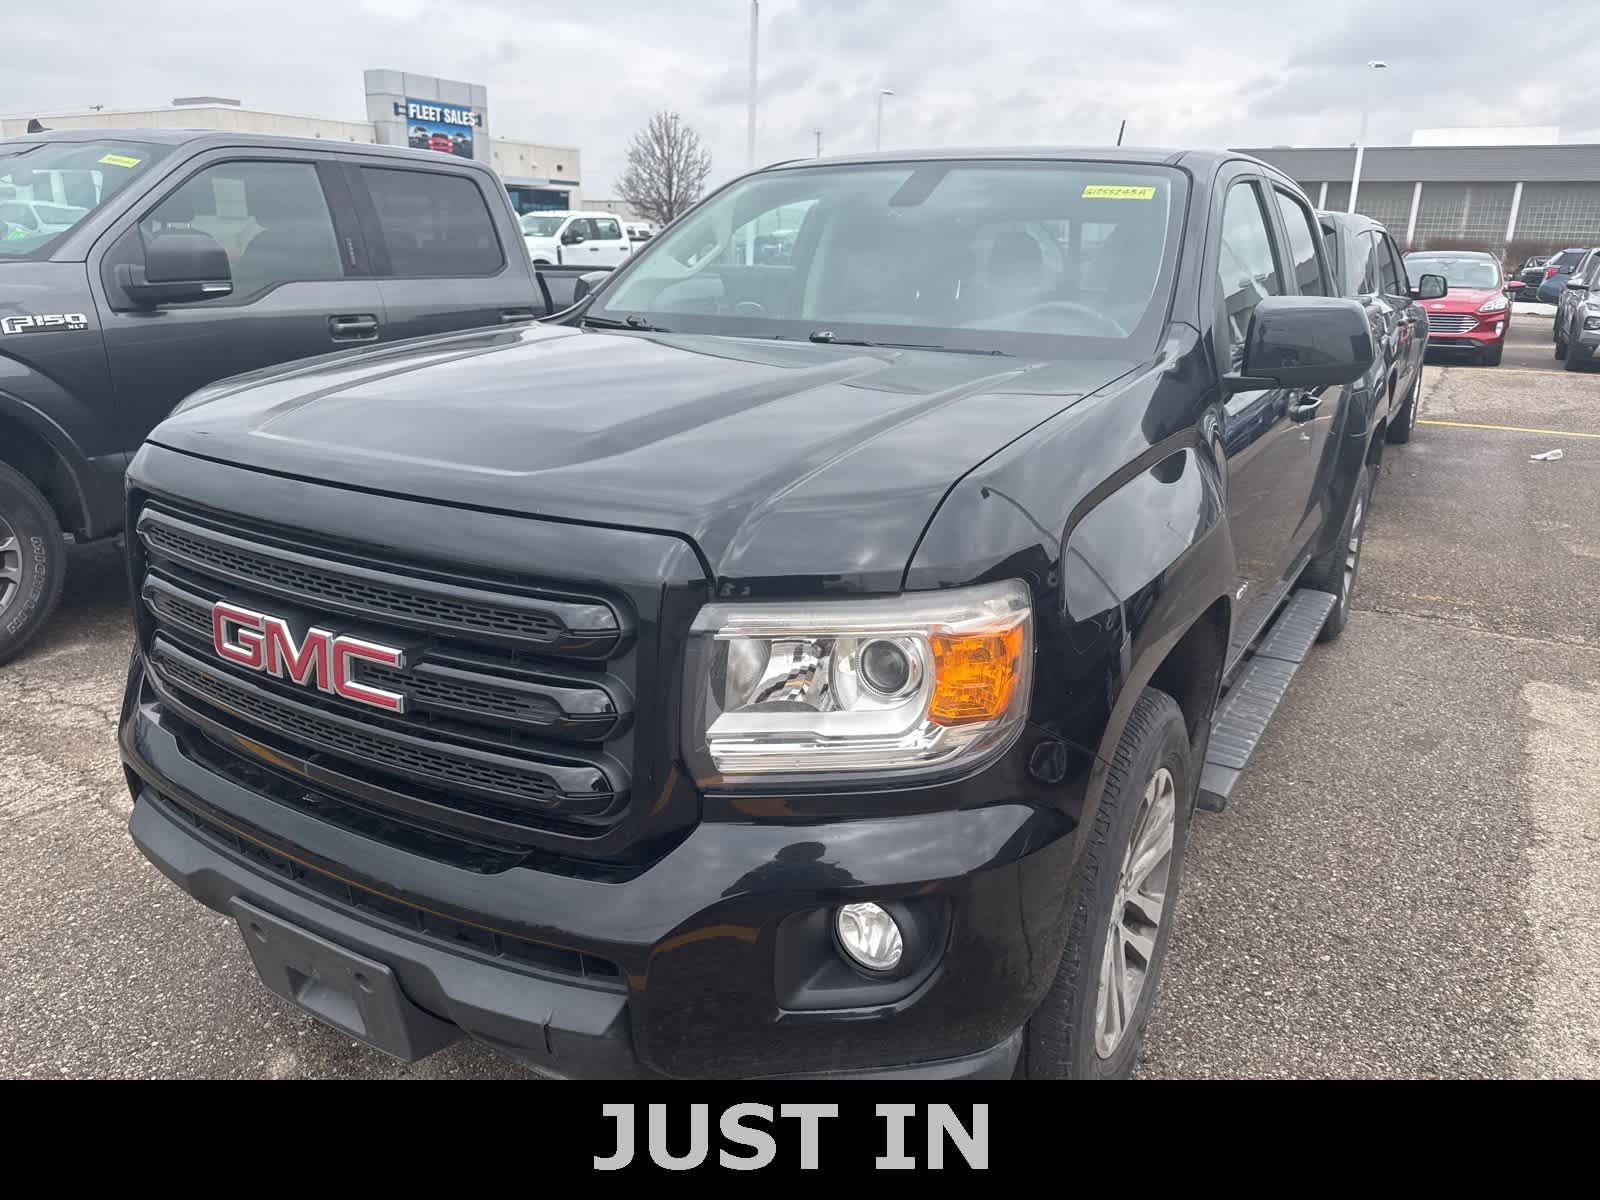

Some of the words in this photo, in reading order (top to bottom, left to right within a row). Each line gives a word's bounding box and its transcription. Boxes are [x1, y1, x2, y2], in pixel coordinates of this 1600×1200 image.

[408, 103, 442, 122] FLEET
[443, 108, 475, 126] SALES
[6, 536, 46, 634] MICHELIN
[212, 601, 404, 713] GMC
